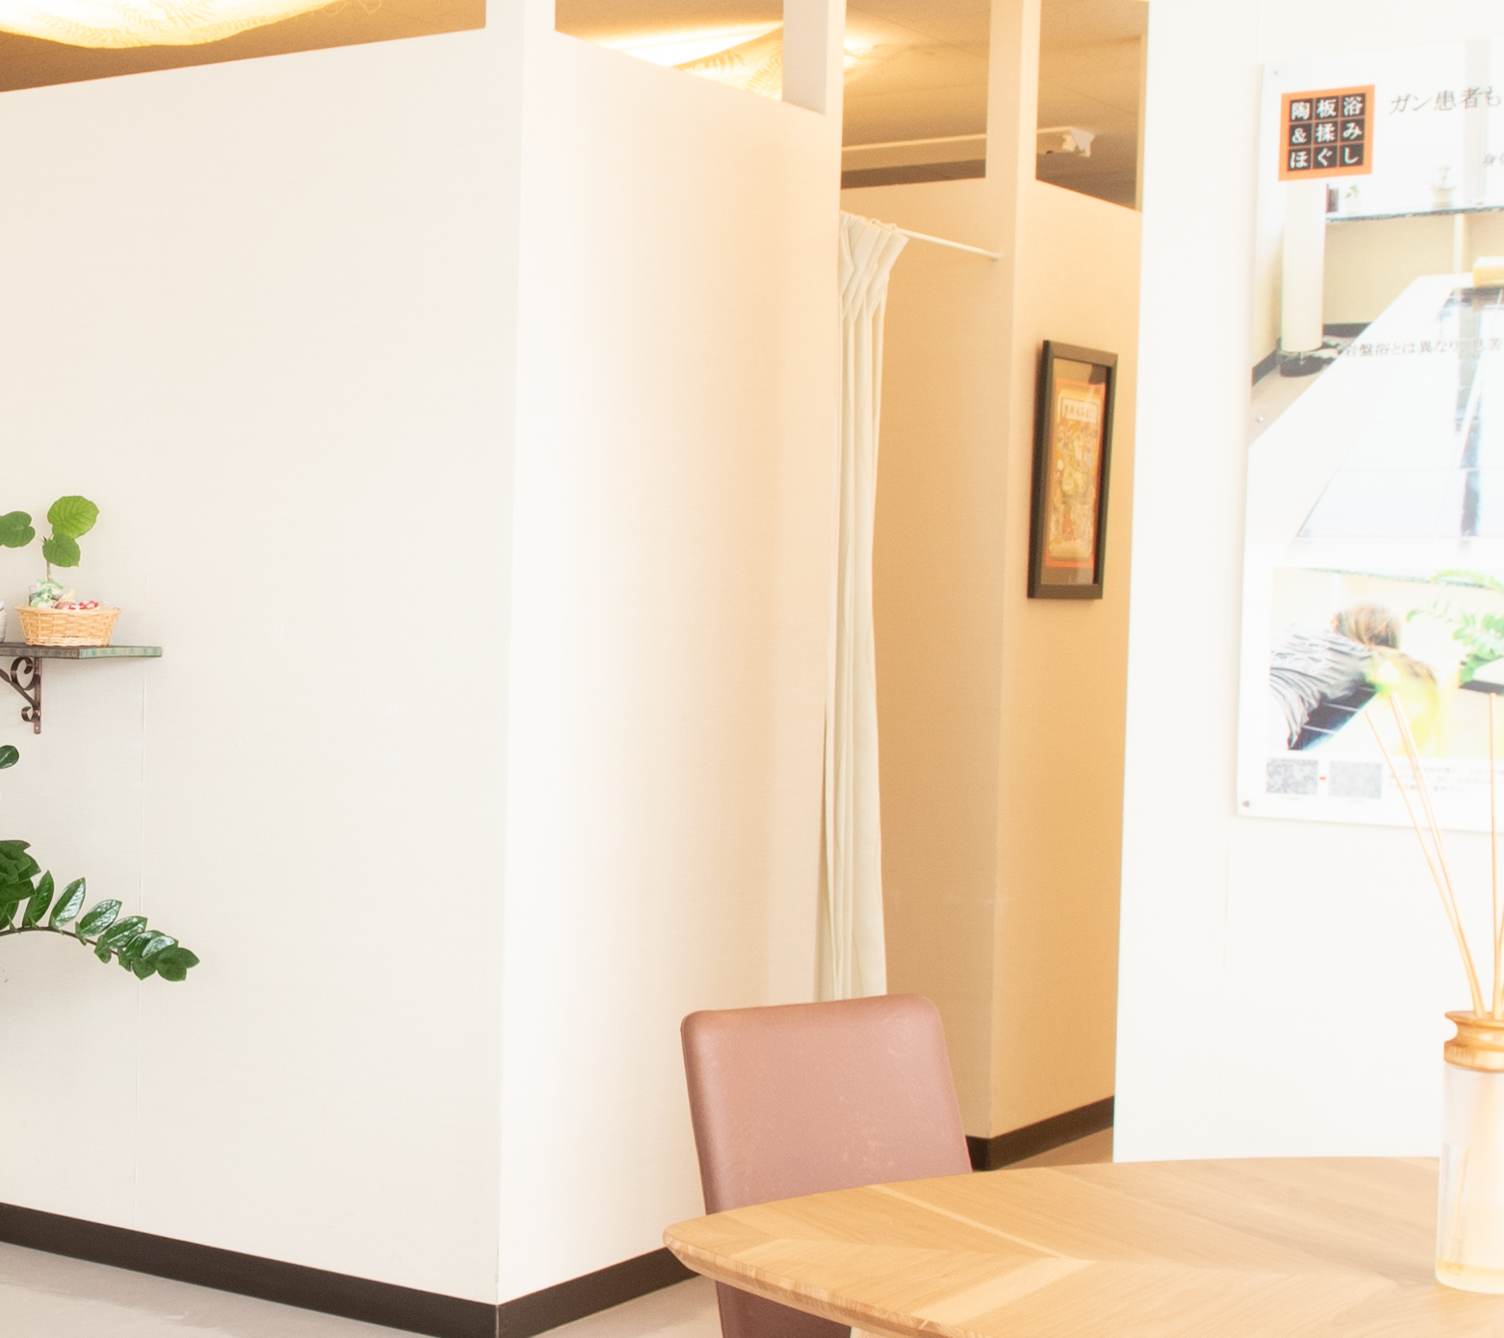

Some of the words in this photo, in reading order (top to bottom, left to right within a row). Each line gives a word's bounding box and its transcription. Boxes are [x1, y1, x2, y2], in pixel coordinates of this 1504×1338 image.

[1291, 94, 1364, 120] 陶板浴
[1289, 145, 1360, 170] ほぐし
